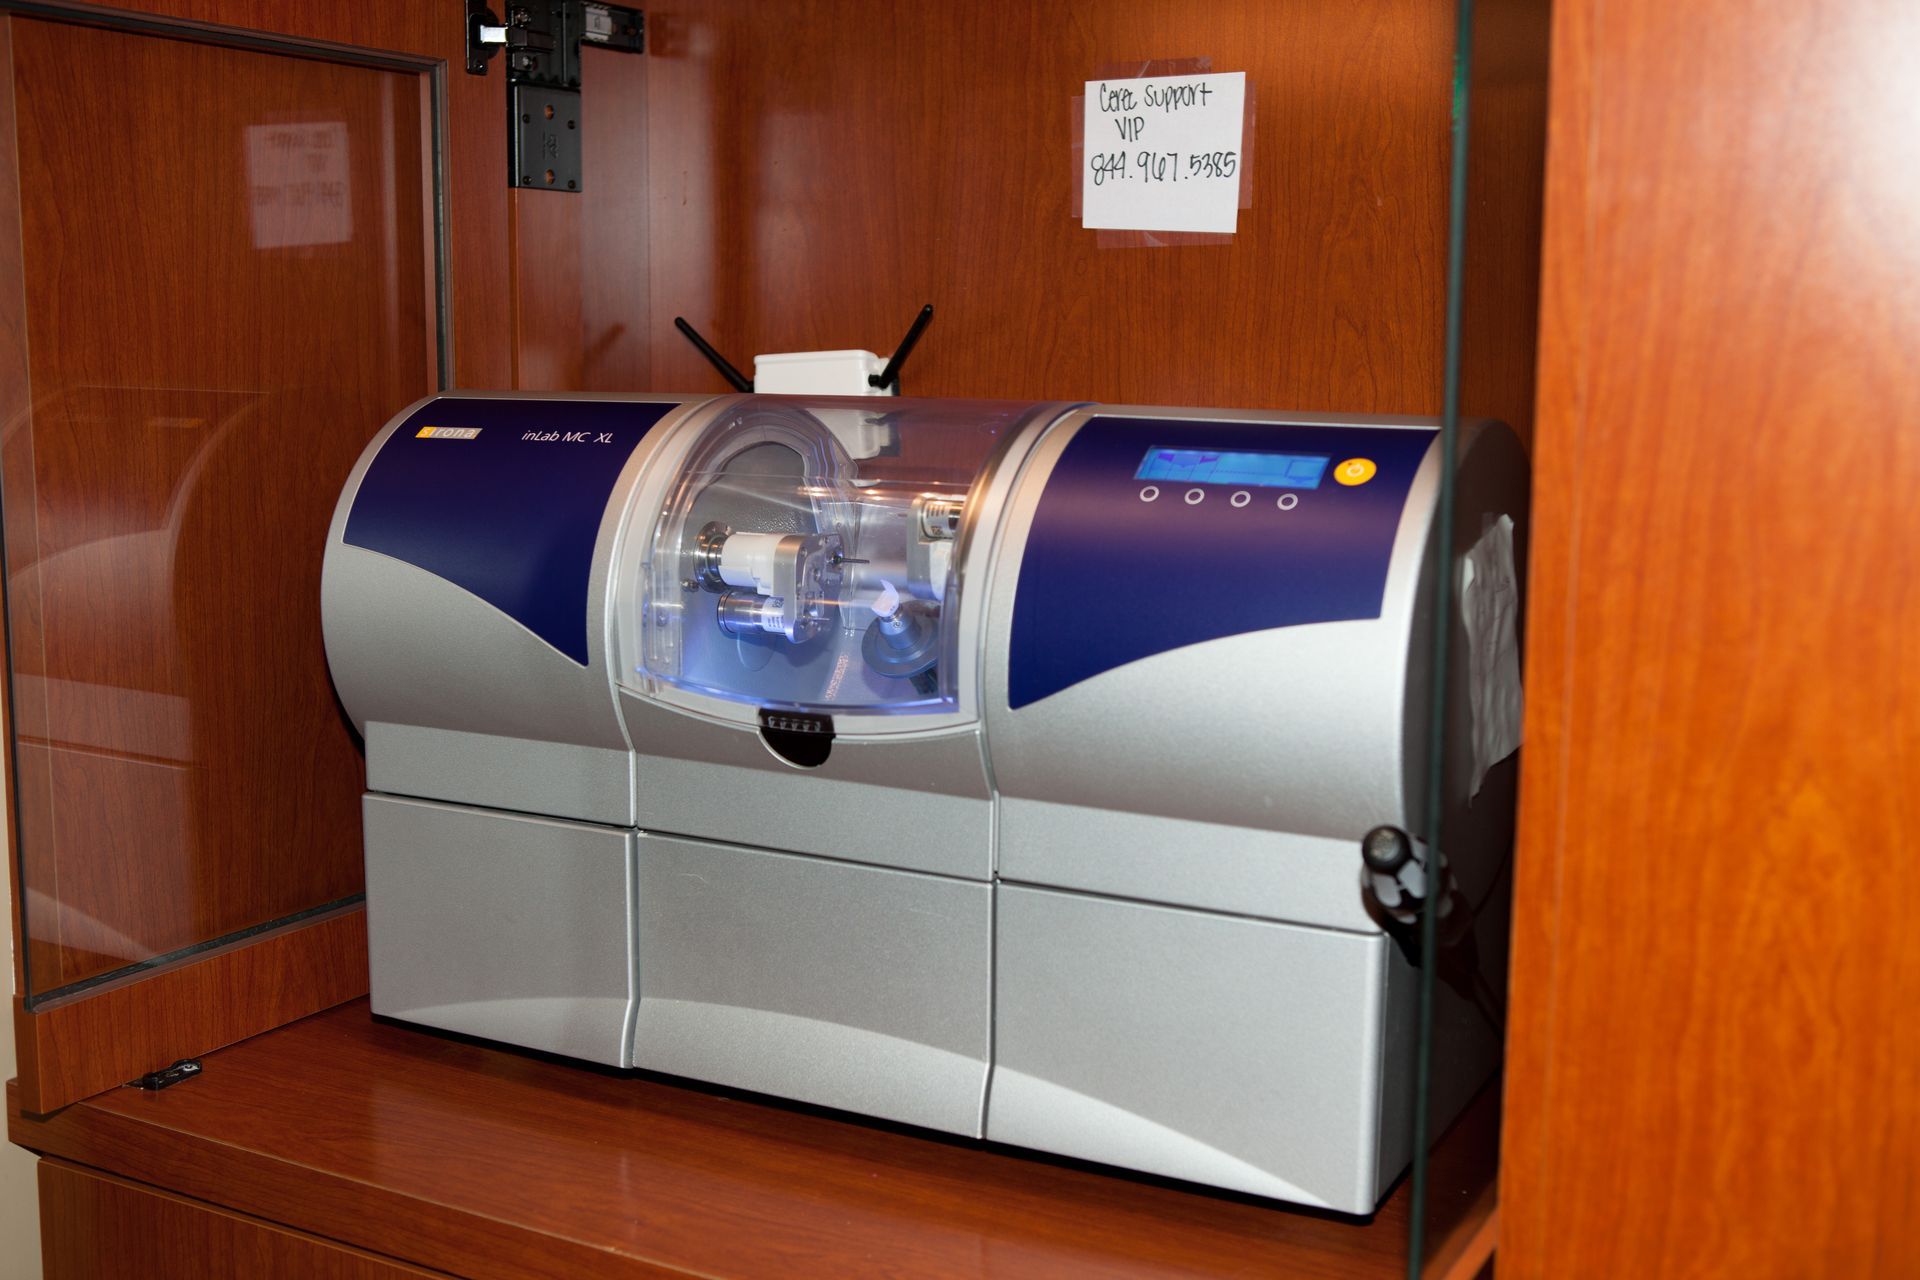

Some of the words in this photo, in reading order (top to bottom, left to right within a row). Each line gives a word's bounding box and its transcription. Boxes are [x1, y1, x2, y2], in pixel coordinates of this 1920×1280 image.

[1144, 82, 1213, 113] Support
[1114, 116, 1145, 142] VIP
[1091, 151, 1237, 186] 844.967.5385
[418, 427, 478, 439] sirona
[521, 430, 560, 442] inLab
[562, 431, 591, 443] MC
[593, 432, 613, 443] XL
